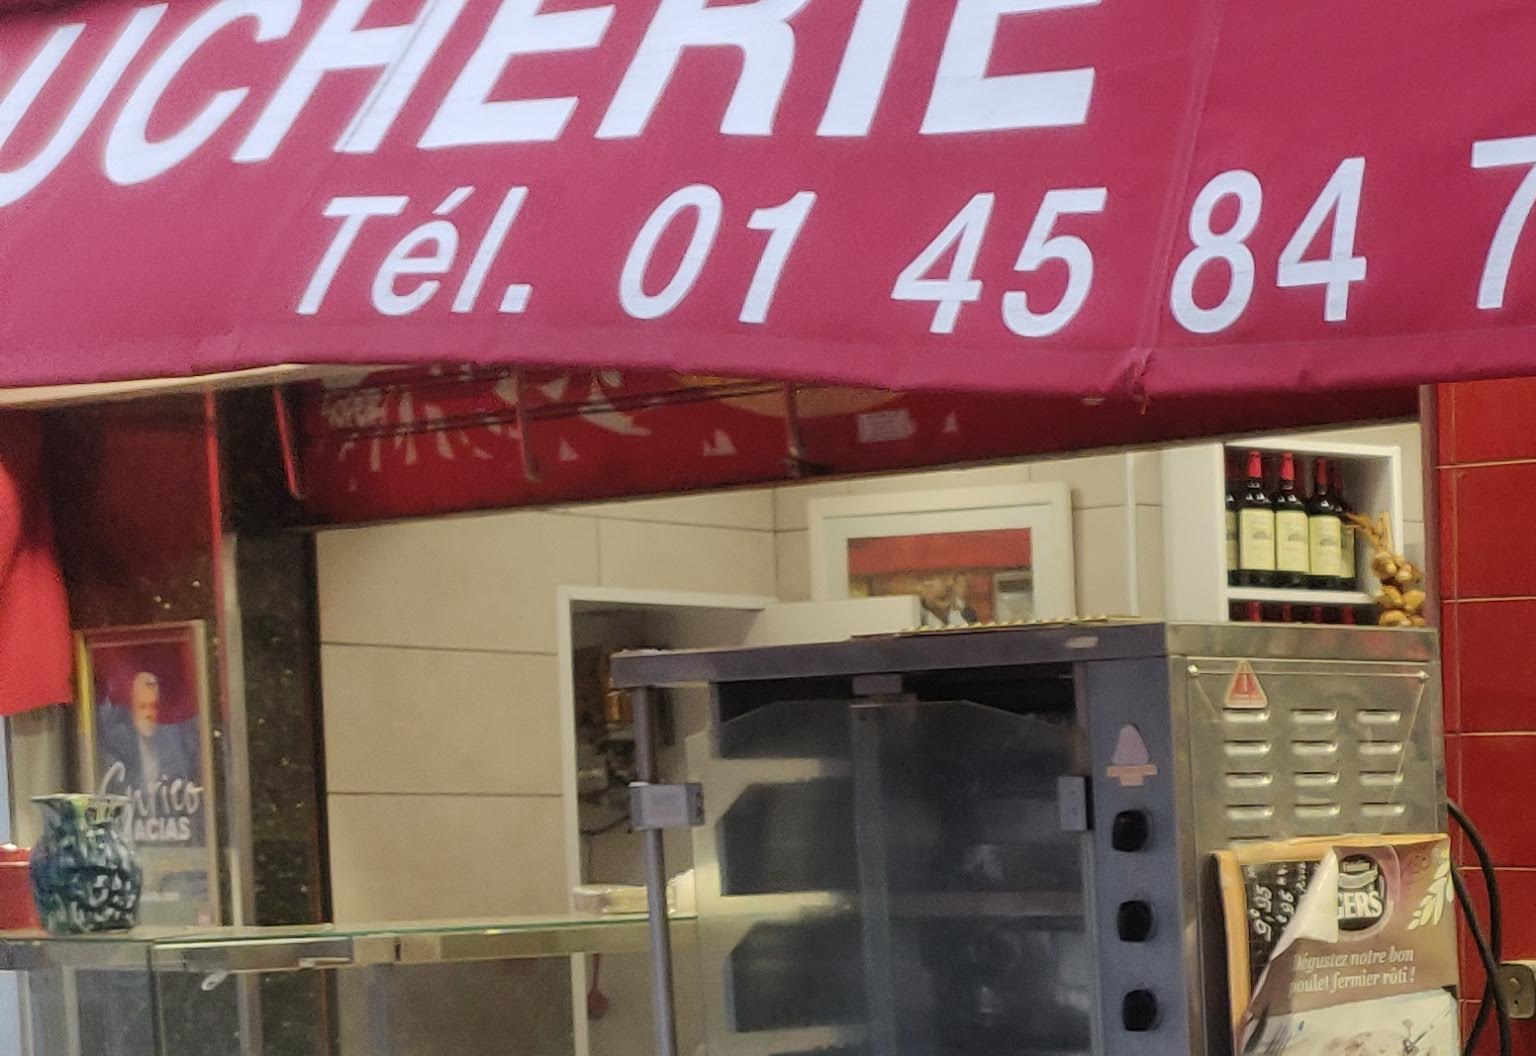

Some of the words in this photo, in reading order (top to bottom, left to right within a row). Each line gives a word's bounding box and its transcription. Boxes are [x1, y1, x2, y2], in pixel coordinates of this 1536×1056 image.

[297, 186, 531, 316] Tél.
[619, 184, 817, 324] 01
[892, 187, 1107, 338] 45
[1170, 156, 1367, 334] 84
[1388, 945, 1414, 962] bon
[1330, 972, 1380, 993] fermier
